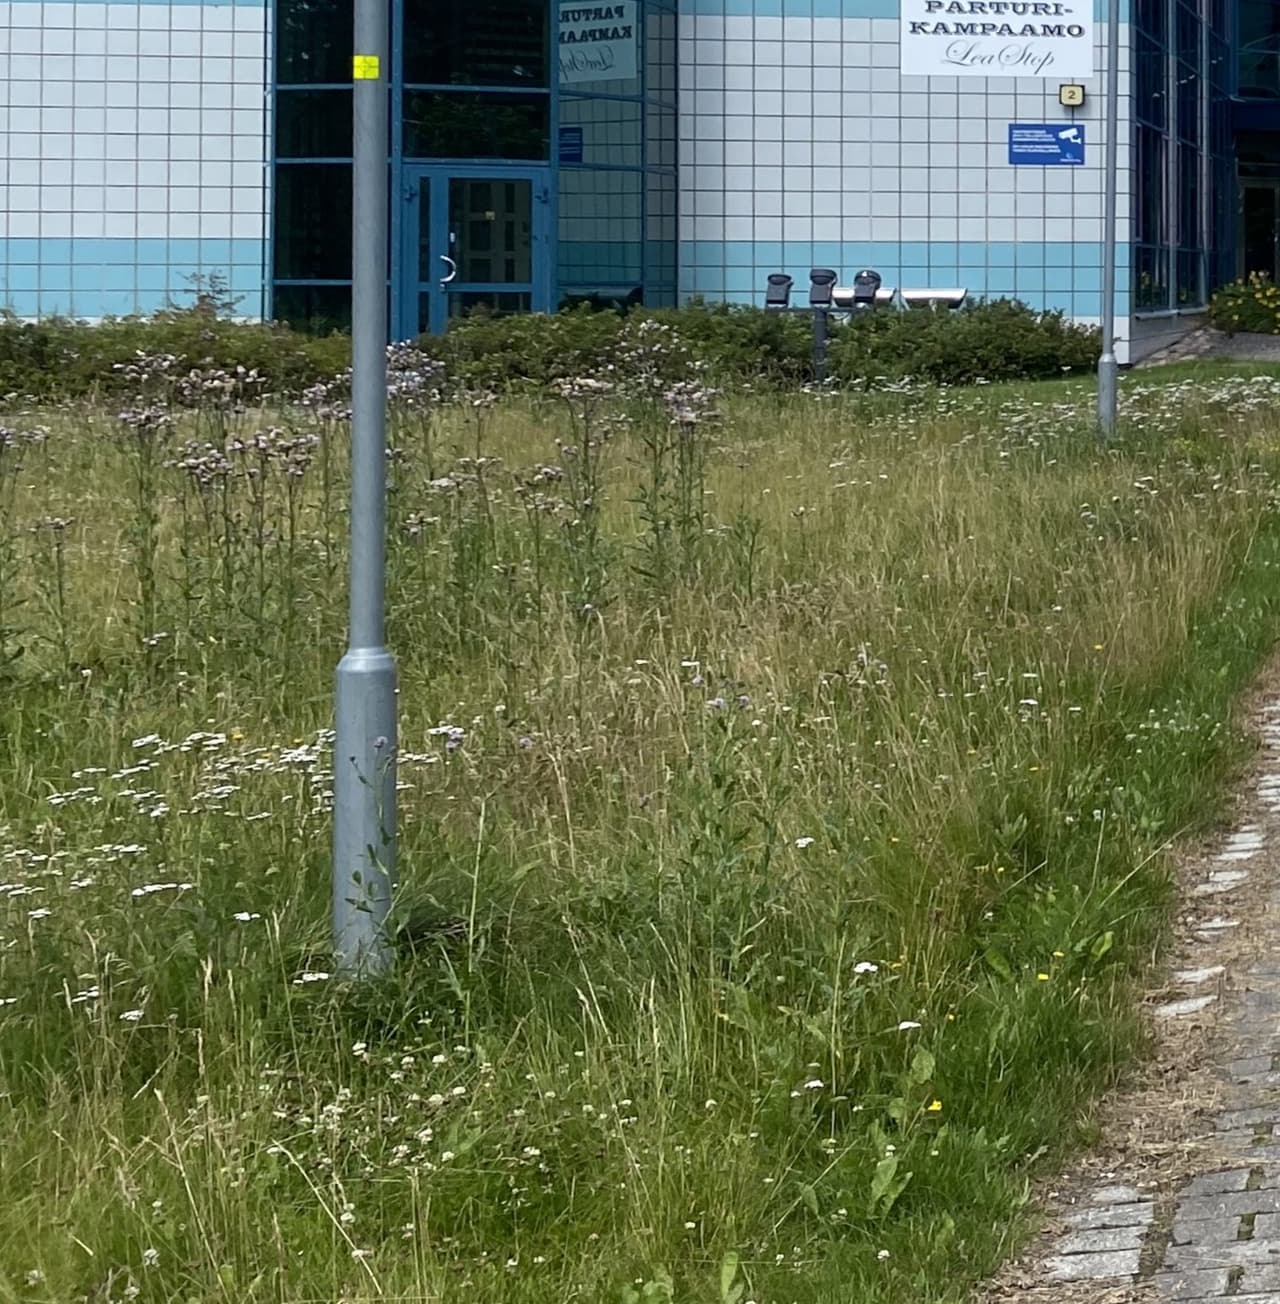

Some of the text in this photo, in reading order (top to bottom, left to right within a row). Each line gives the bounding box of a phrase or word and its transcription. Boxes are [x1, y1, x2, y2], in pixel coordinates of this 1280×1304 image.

[925, 0, 1073, 16] PARTURI-
[909, 21, 1085, 38] KAMPAAMO
[1066, 90, 1077, 100] 2
